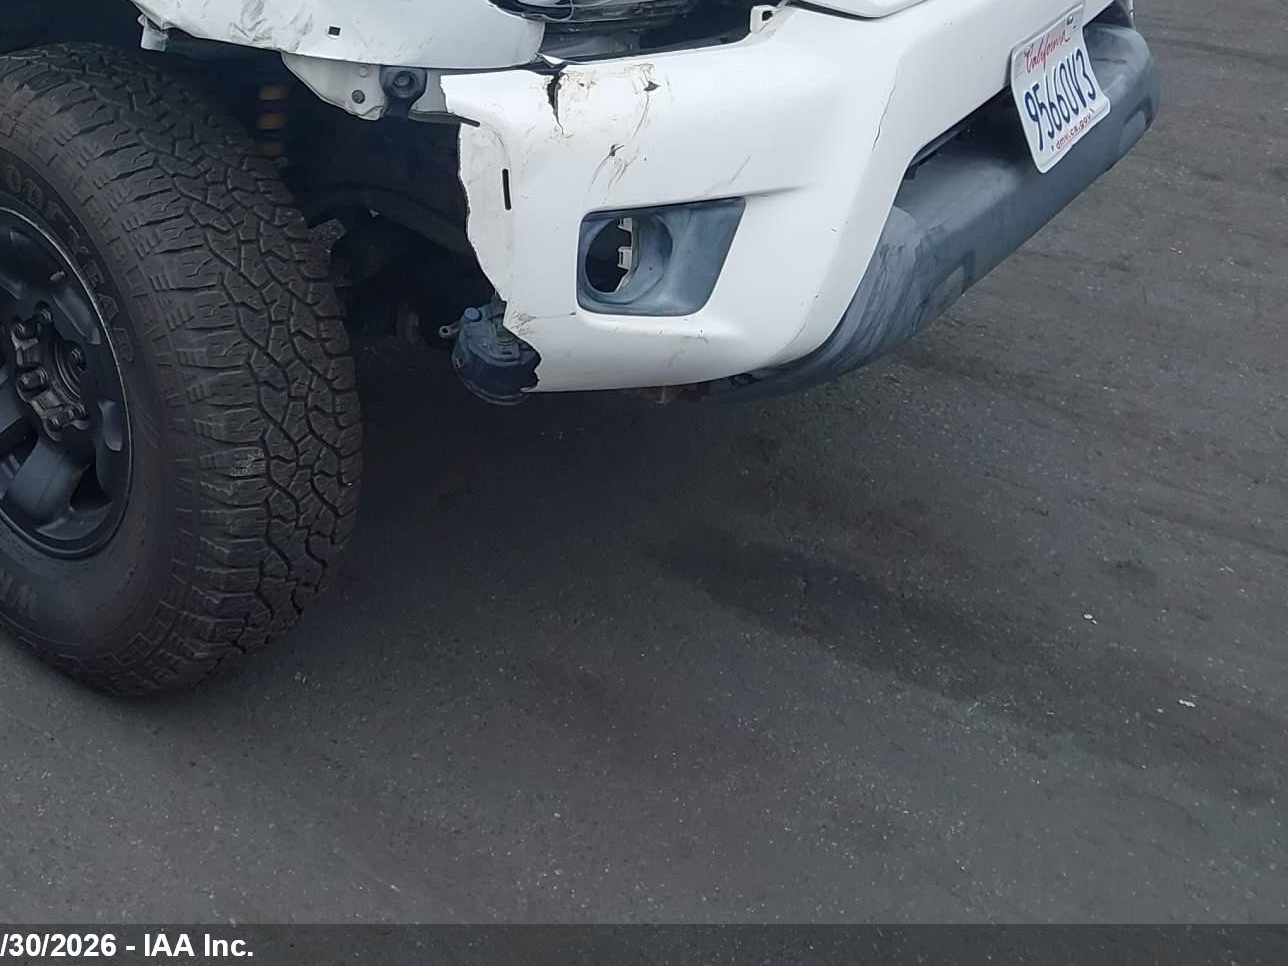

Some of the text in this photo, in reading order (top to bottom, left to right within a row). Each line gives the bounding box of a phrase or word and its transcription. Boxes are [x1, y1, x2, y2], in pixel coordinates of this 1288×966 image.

[1023, 29, 1072, 74] California
[1024, 48, 1097, 152] 95660V3
[1055, 113, 1093, 151] dmv.ca.gov
